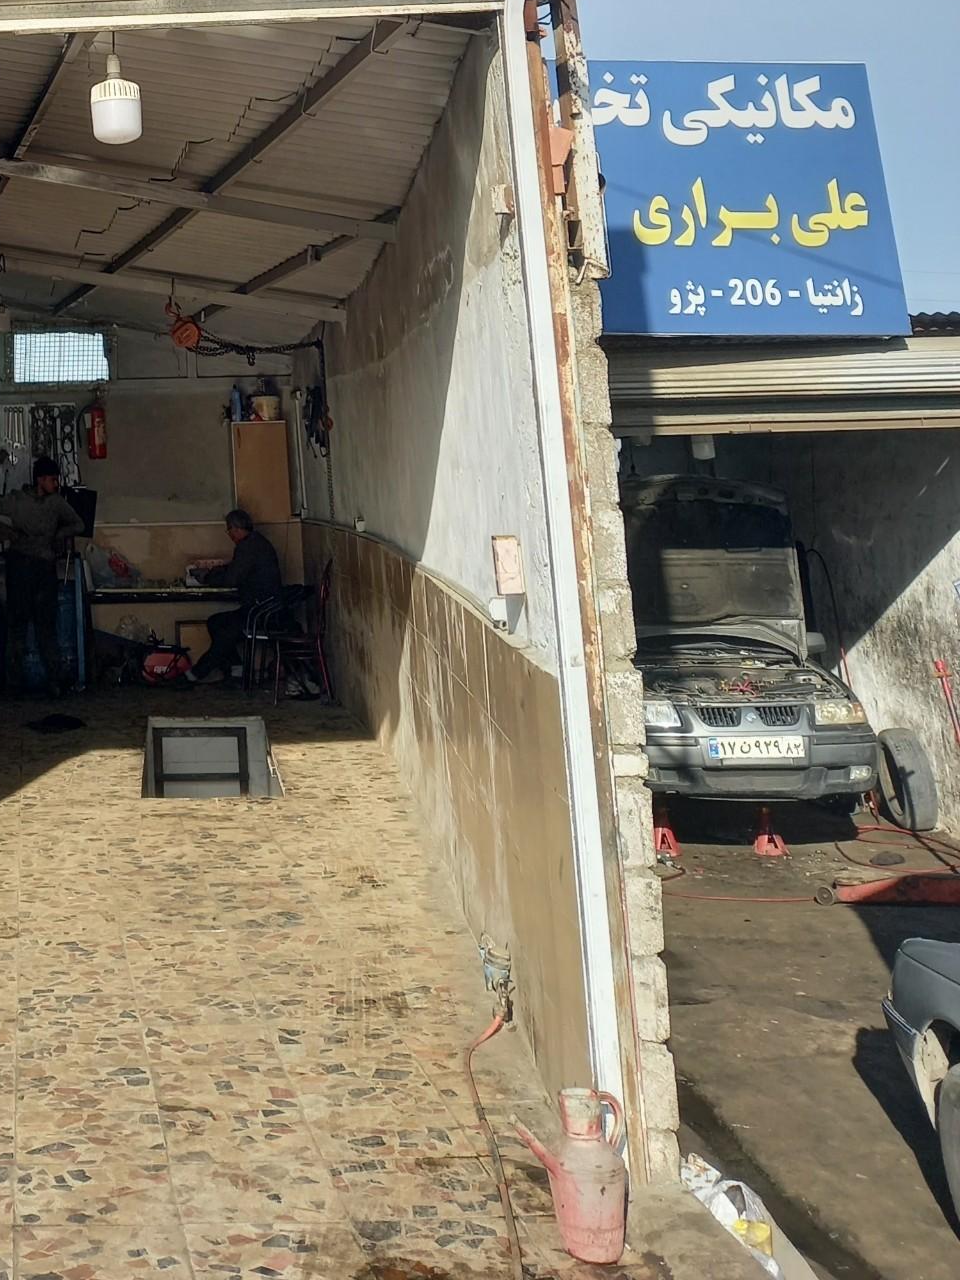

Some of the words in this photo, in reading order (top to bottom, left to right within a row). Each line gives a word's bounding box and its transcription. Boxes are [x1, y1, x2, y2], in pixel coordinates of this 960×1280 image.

[662, 72, 856, 146] مکانیکی
[633, 176, 780, 247] براری
[791, 177, 869, 247] علی
[668, 279, 706, 317] پژو
[728, 278, 782, 306] 206
[806, 277, 864, 316] زانتیا
[720, 740, 736, 756] ۱۷
[740, 740, 751, 754] ن
[754, 739, 782, 755] ۹۲۹
